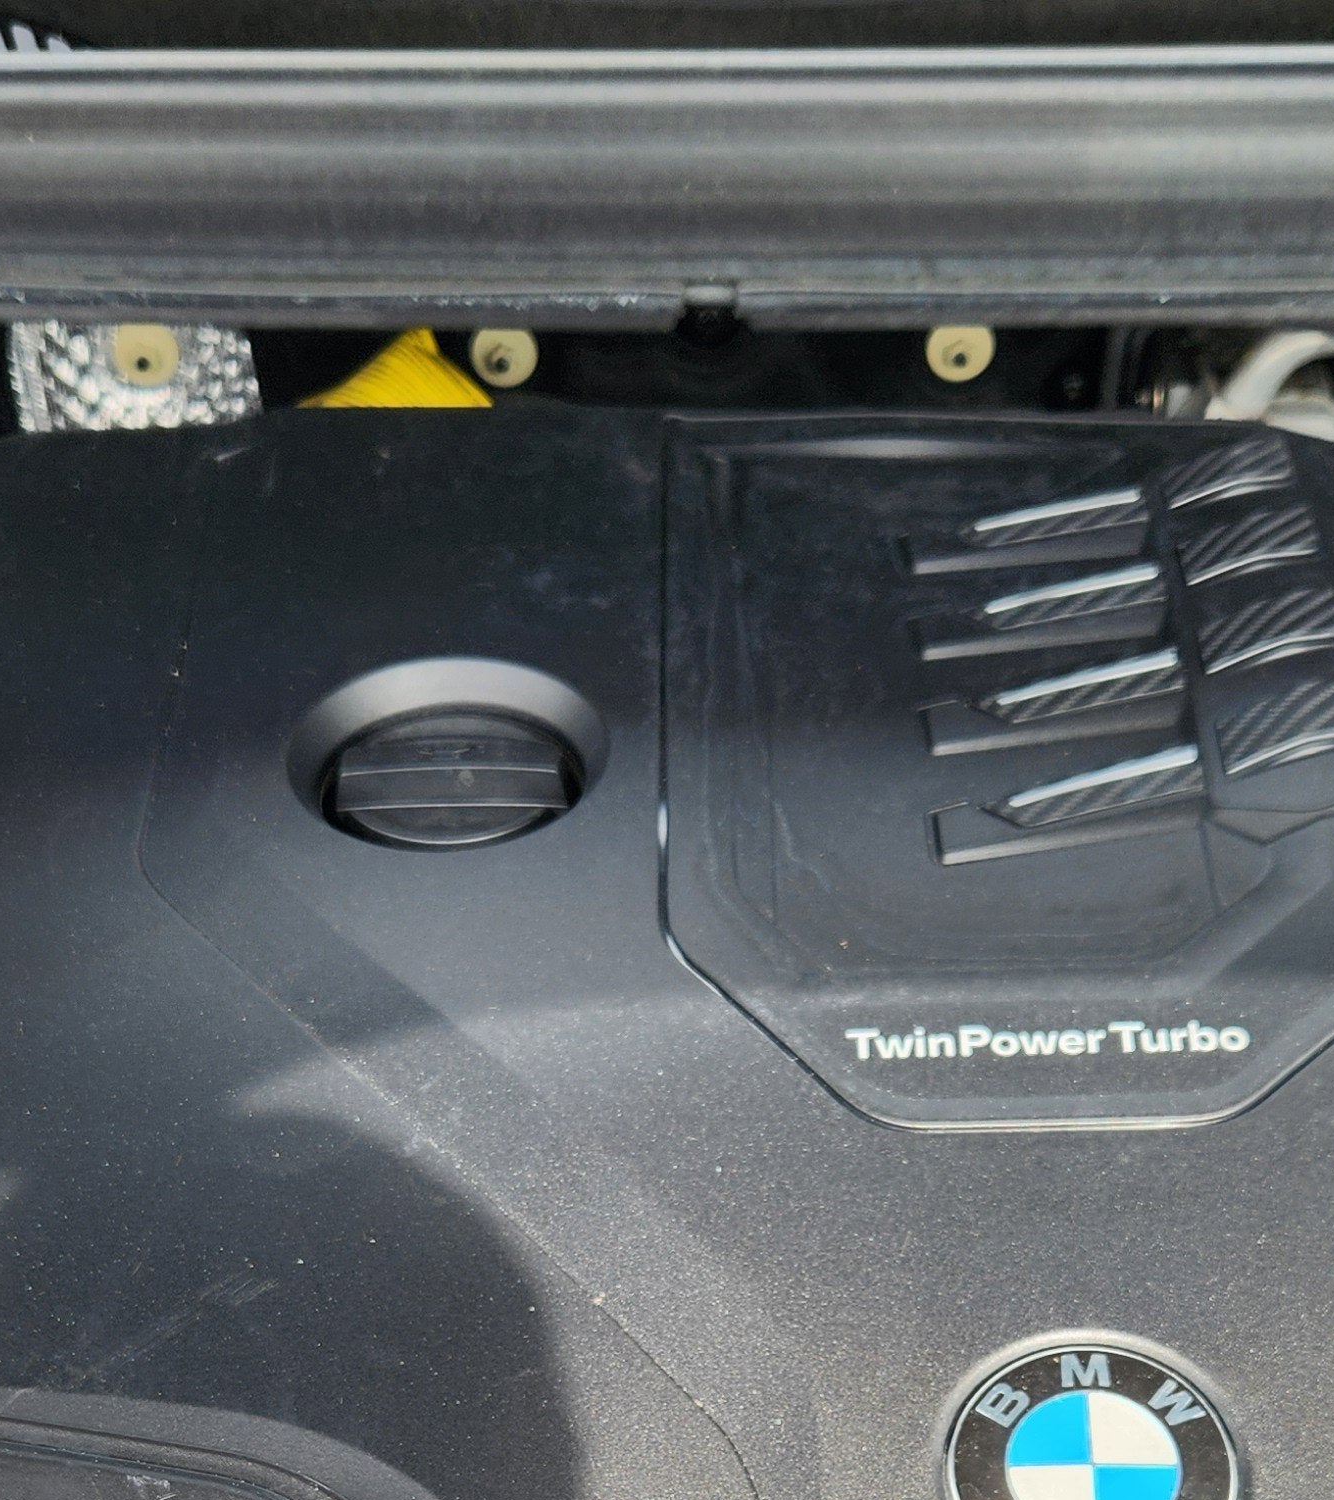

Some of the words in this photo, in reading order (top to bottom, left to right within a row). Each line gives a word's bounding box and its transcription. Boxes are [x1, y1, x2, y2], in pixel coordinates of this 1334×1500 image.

[845, 1024, 1106, 1060] TwinPower
[1108, 1019, 1251, 1054] Turbo
[975, 1353, 1206, 1428] BMW
